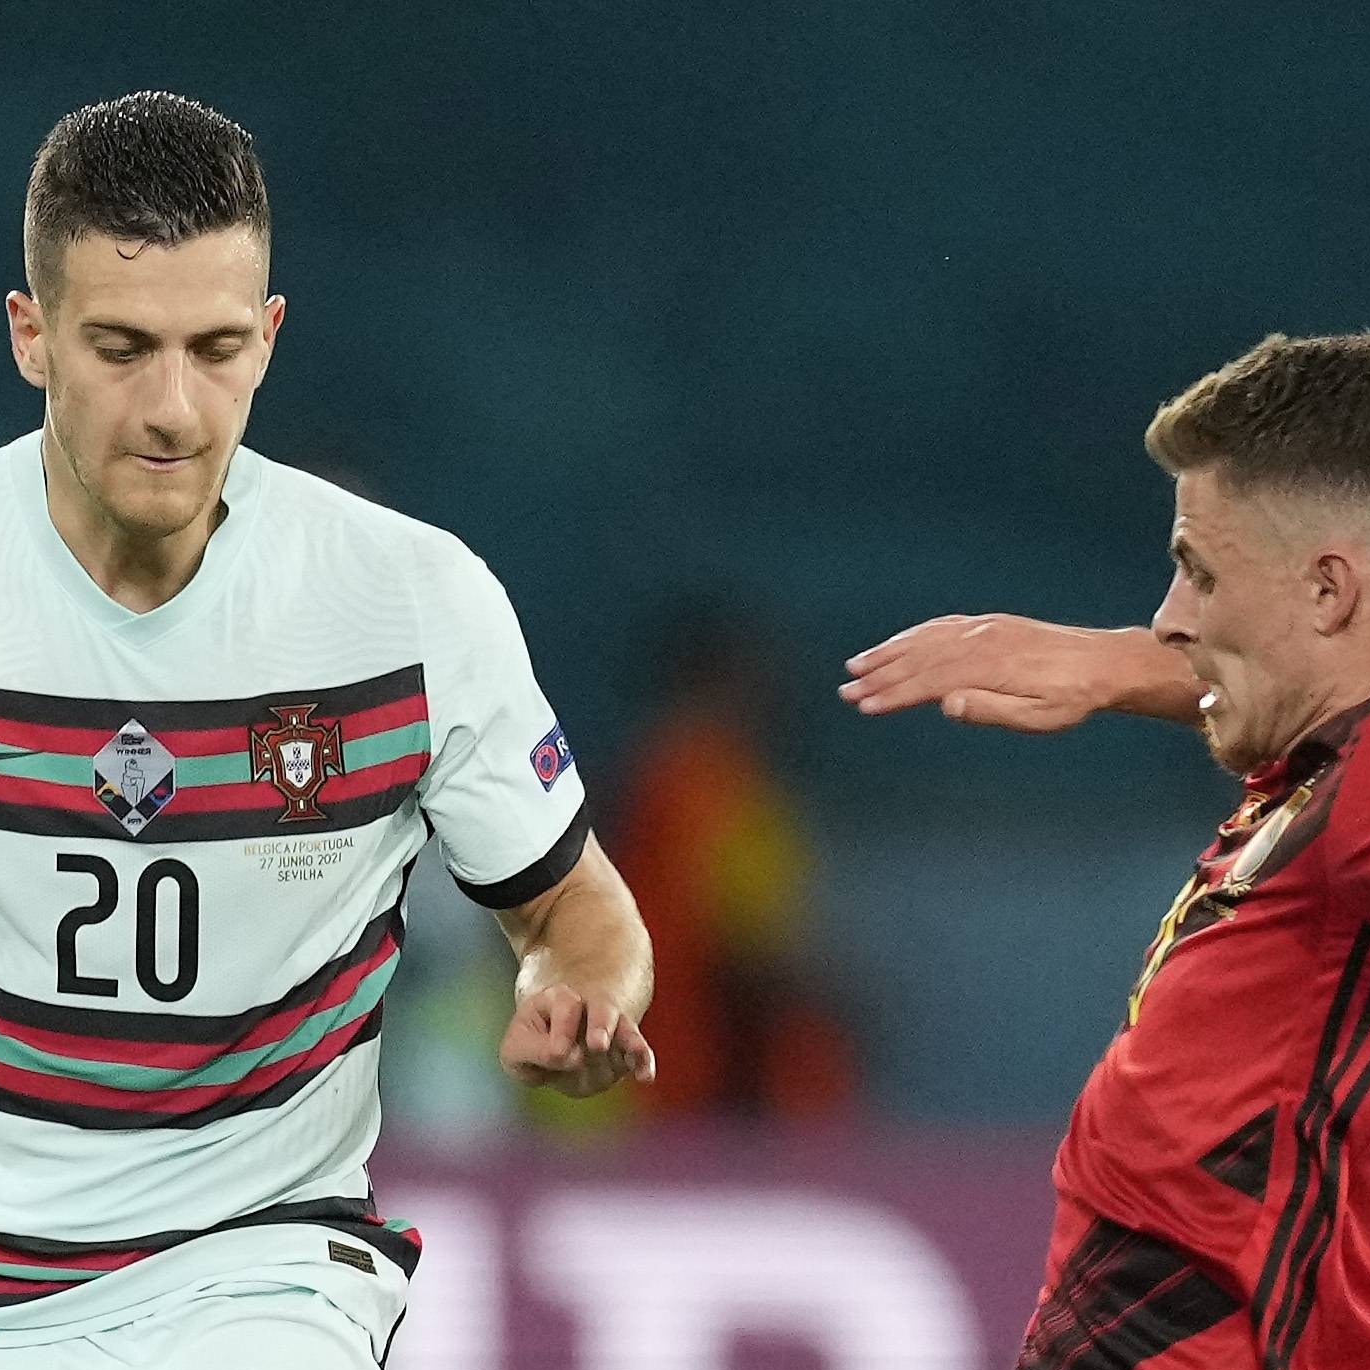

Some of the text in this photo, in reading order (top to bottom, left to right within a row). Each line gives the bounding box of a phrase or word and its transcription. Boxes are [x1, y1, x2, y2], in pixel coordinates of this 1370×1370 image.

[260, 852, 342, 870] 27 JUNHO 2021
[277, 868, 324, 883] SEVILHA
[56, 853, 199, 1003] 20
